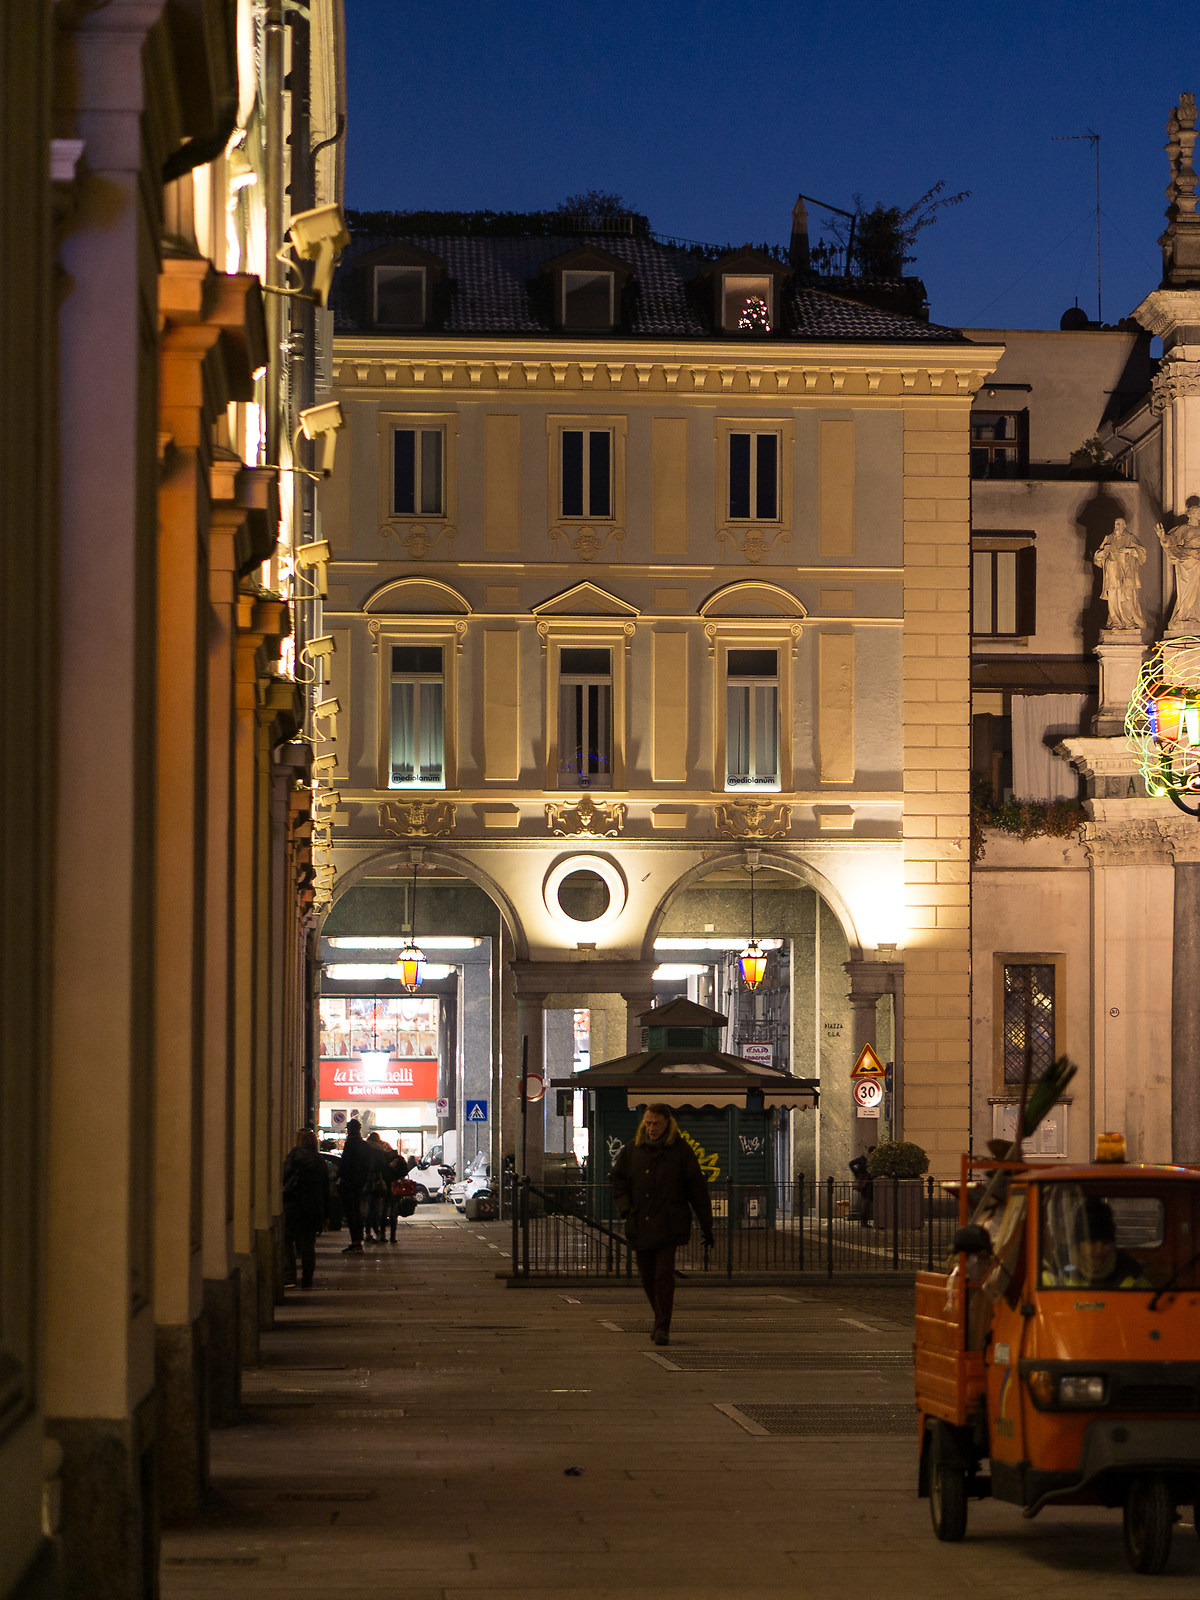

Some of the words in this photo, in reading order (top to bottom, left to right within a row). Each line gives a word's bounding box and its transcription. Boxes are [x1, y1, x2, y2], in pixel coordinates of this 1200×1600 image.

[393, 773, 440, 782] mediolanum
[728, 775, 775, 784] mediolanum
[333, 1068, 346, 1082] la
[372, 1086, 399, 1095] Musica
[860, 1086, 875, 1098] 30
